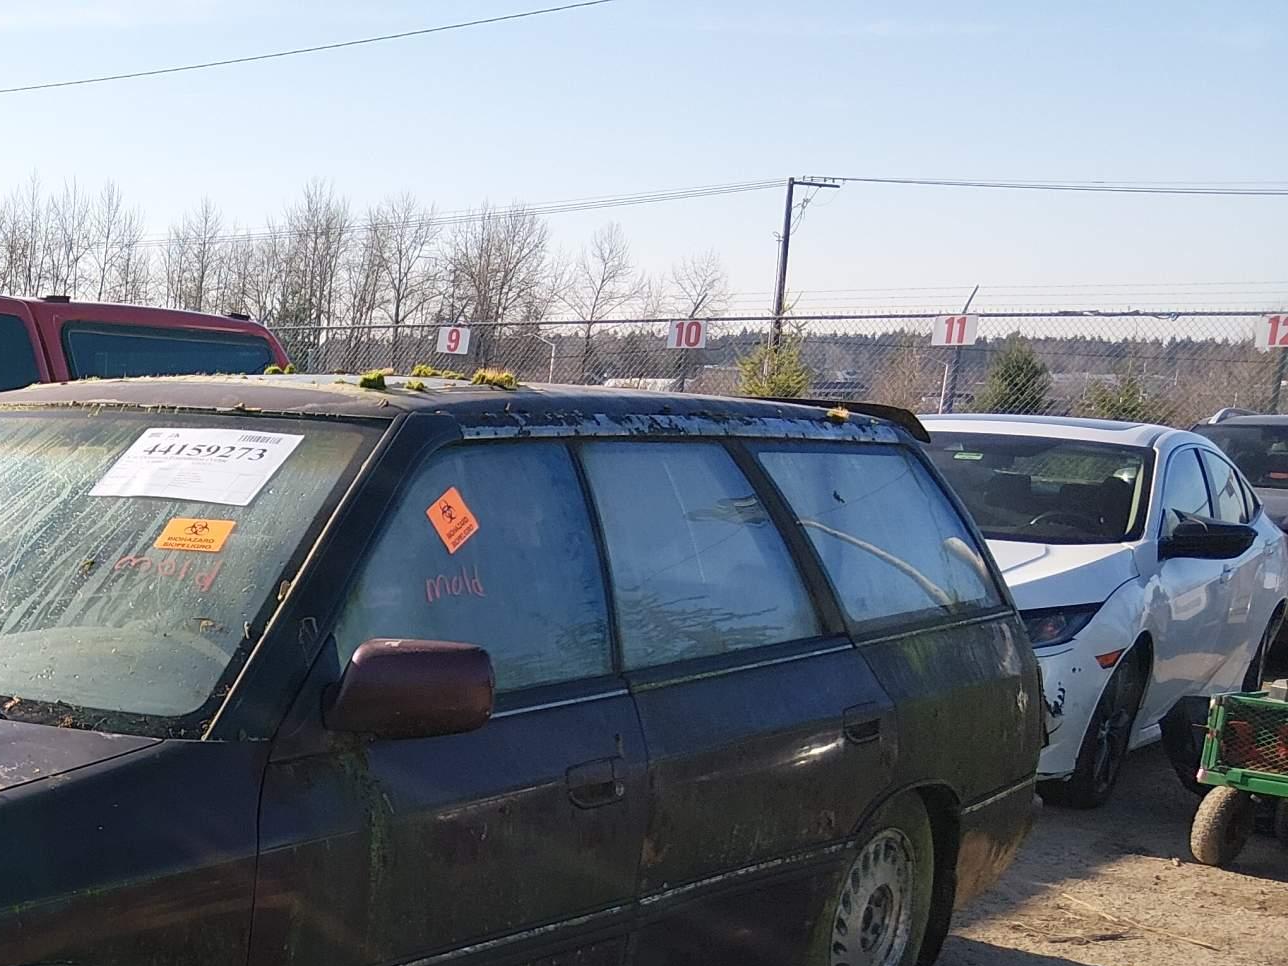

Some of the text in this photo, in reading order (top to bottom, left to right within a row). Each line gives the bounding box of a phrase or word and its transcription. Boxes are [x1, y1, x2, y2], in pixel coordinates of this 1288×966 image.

[446, 329, 461, 352] 9
[675, 321, 702, 347] 10
[944, 316, 967, 344] 11
[143, 443, 267, 461] 44159273
[425, 565, 486, 602] mold
